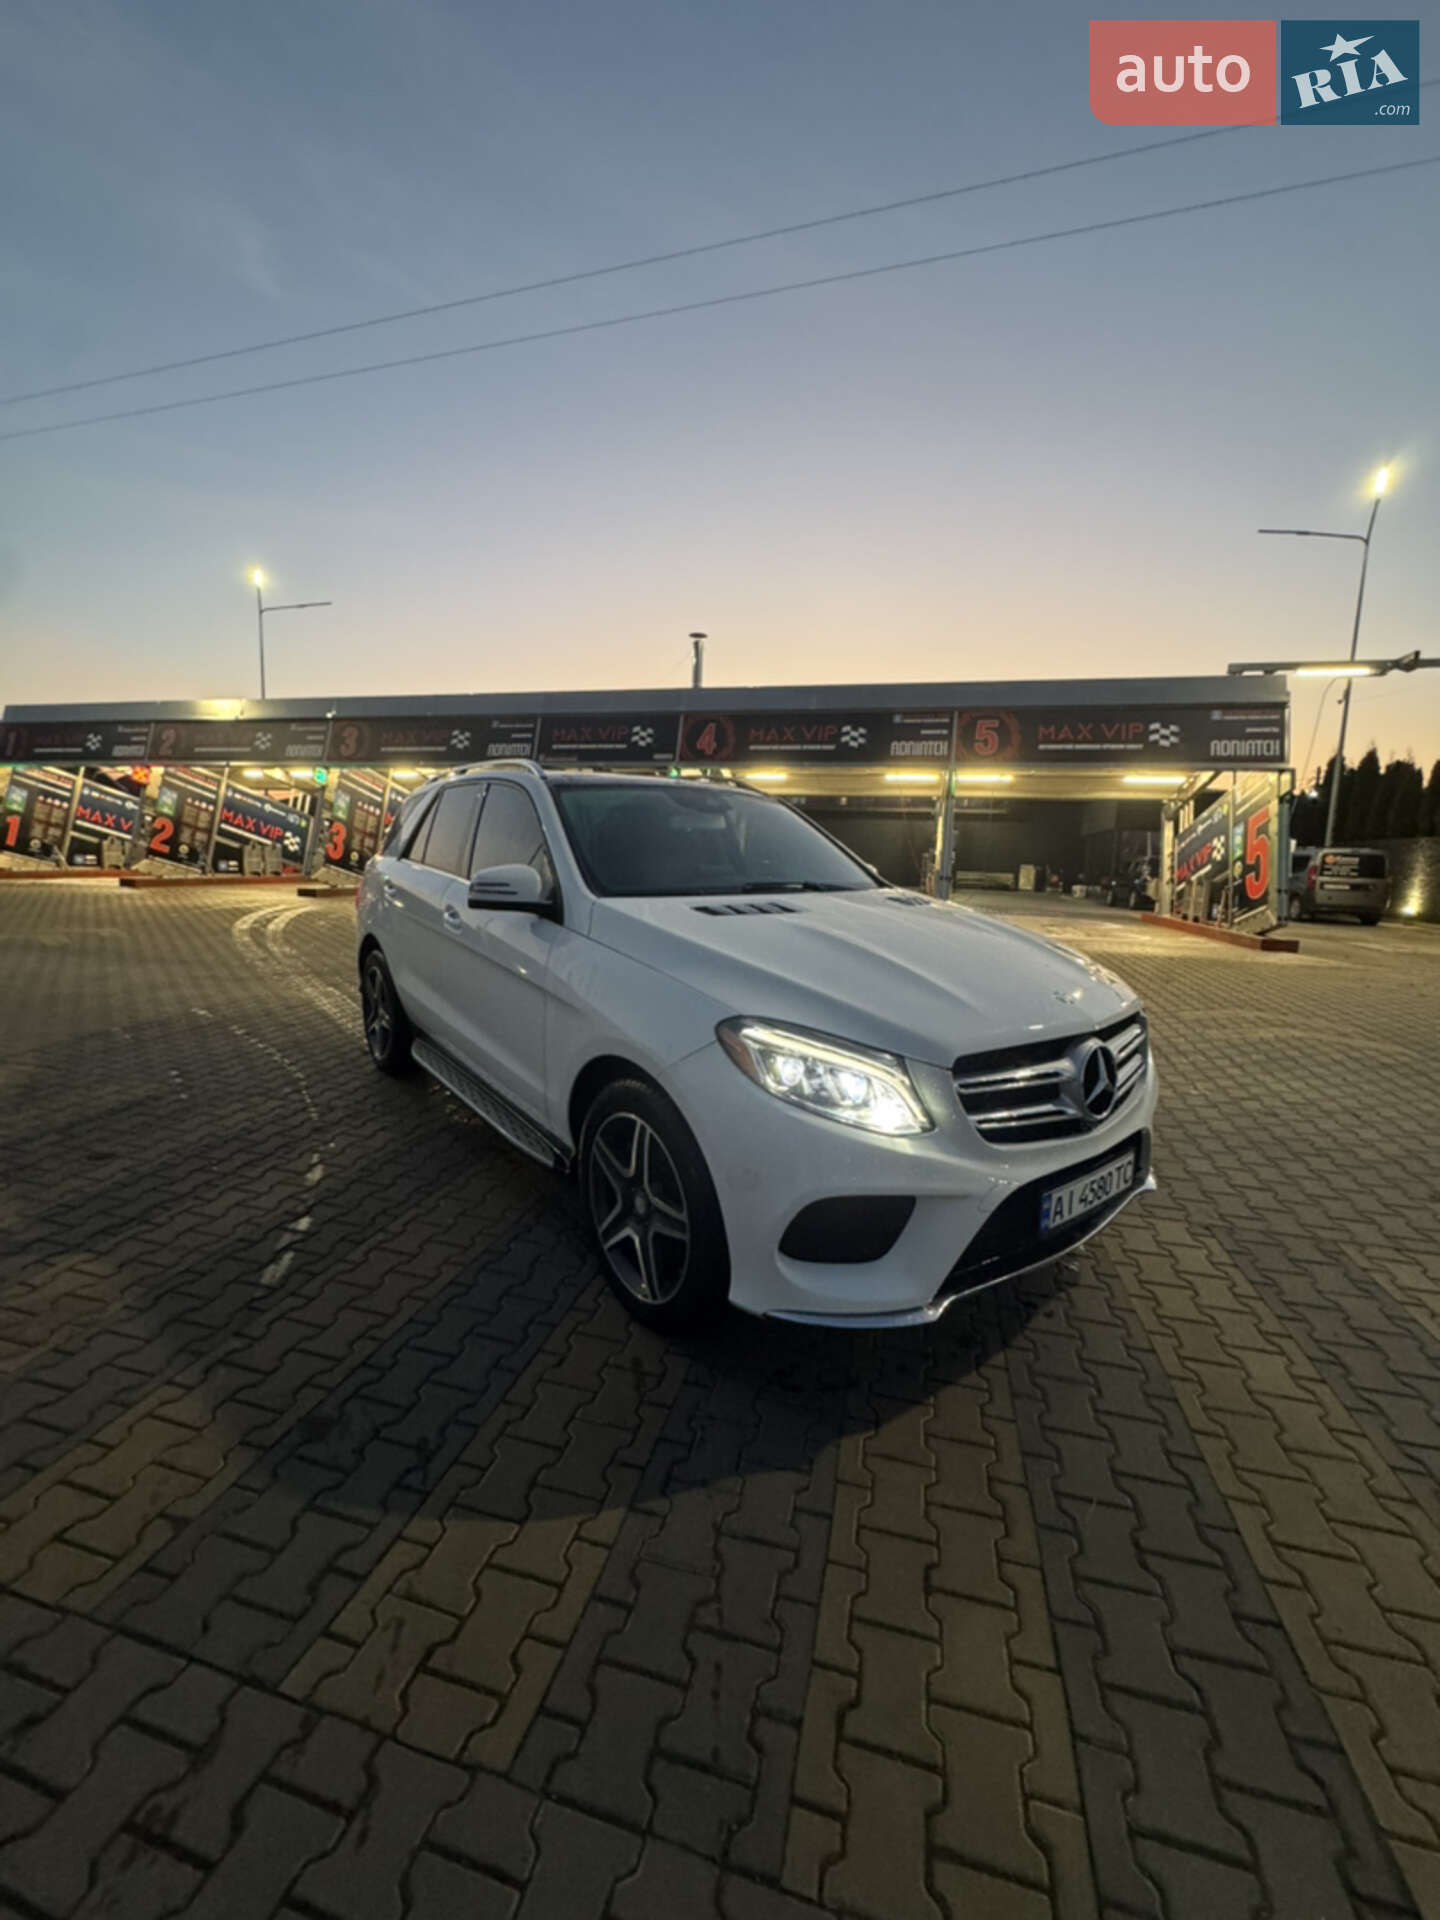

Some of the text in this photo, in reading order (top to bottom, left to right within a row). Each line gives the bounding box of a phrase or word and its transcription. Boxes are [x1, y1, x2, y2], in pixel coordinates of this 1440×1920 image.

[339, 727, 360, 757] 3
[551, 724, 629, 742] MAX VIP
[695, 722, 717, 756] 4
[748, 725, 838, 742] MAX VIP
[973, 719, 1000, 756] 5
[1037, 721, 1145, 741] MAX VIP
[4, 815, 21, 848] 1
[76, 805, 114, 828] MAX
[220, 807, 286, 838] MAX VIP
[149, 817, 174, 855] 2
[325, 822, 348, 862] 3
[1246, 805, 1271, 898] 5
[1053, 1161, 1133, 1224] AI 4580 TC
